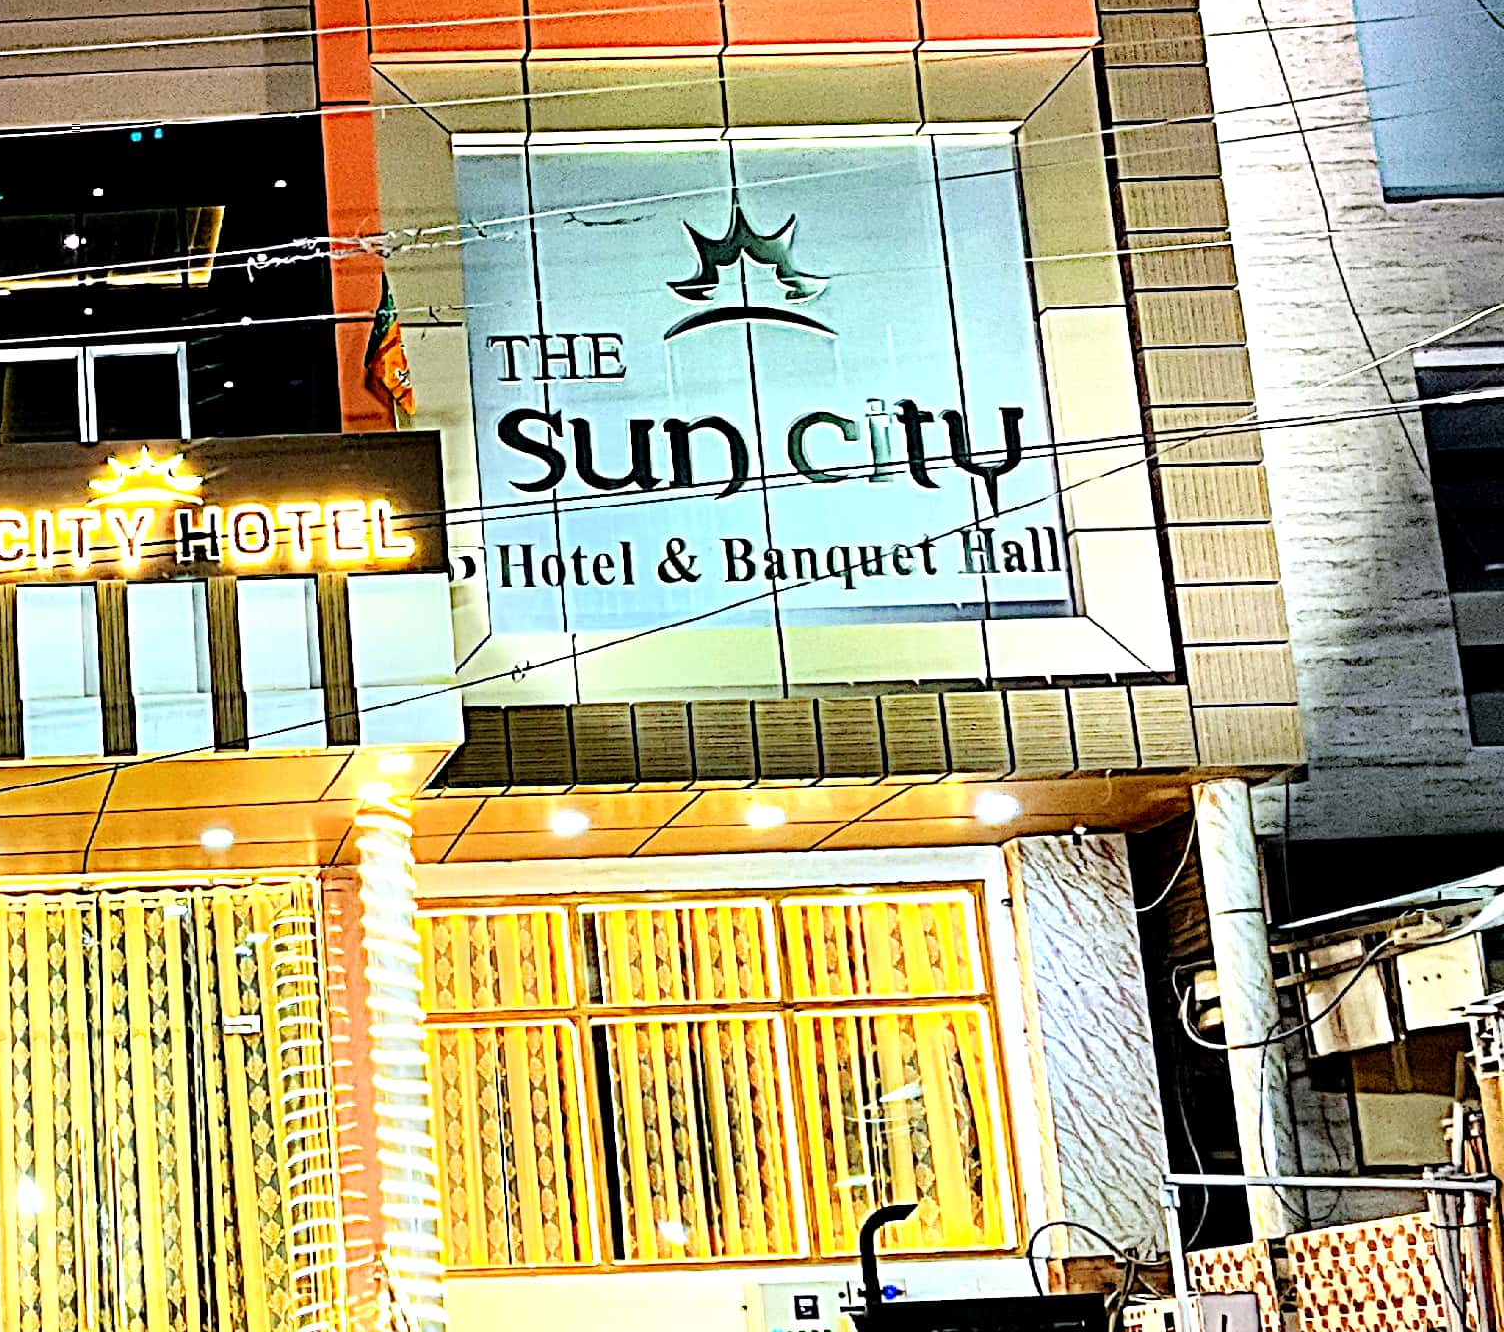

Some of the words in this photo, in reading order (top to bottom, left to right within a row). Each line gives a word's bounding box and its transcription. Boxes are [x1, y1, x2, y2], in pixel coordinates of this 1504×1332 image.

[487, 333, 627, 383] THE
[498, 408, 749, 499] Sun
[174, 502, 415, 562] HOTEL
[497, 540, 635, 588] Hotel
[656, 536, 702, 584] &
[724, 536, 939, 589] Banquet
[958, 525, 1062, 574] Hall
